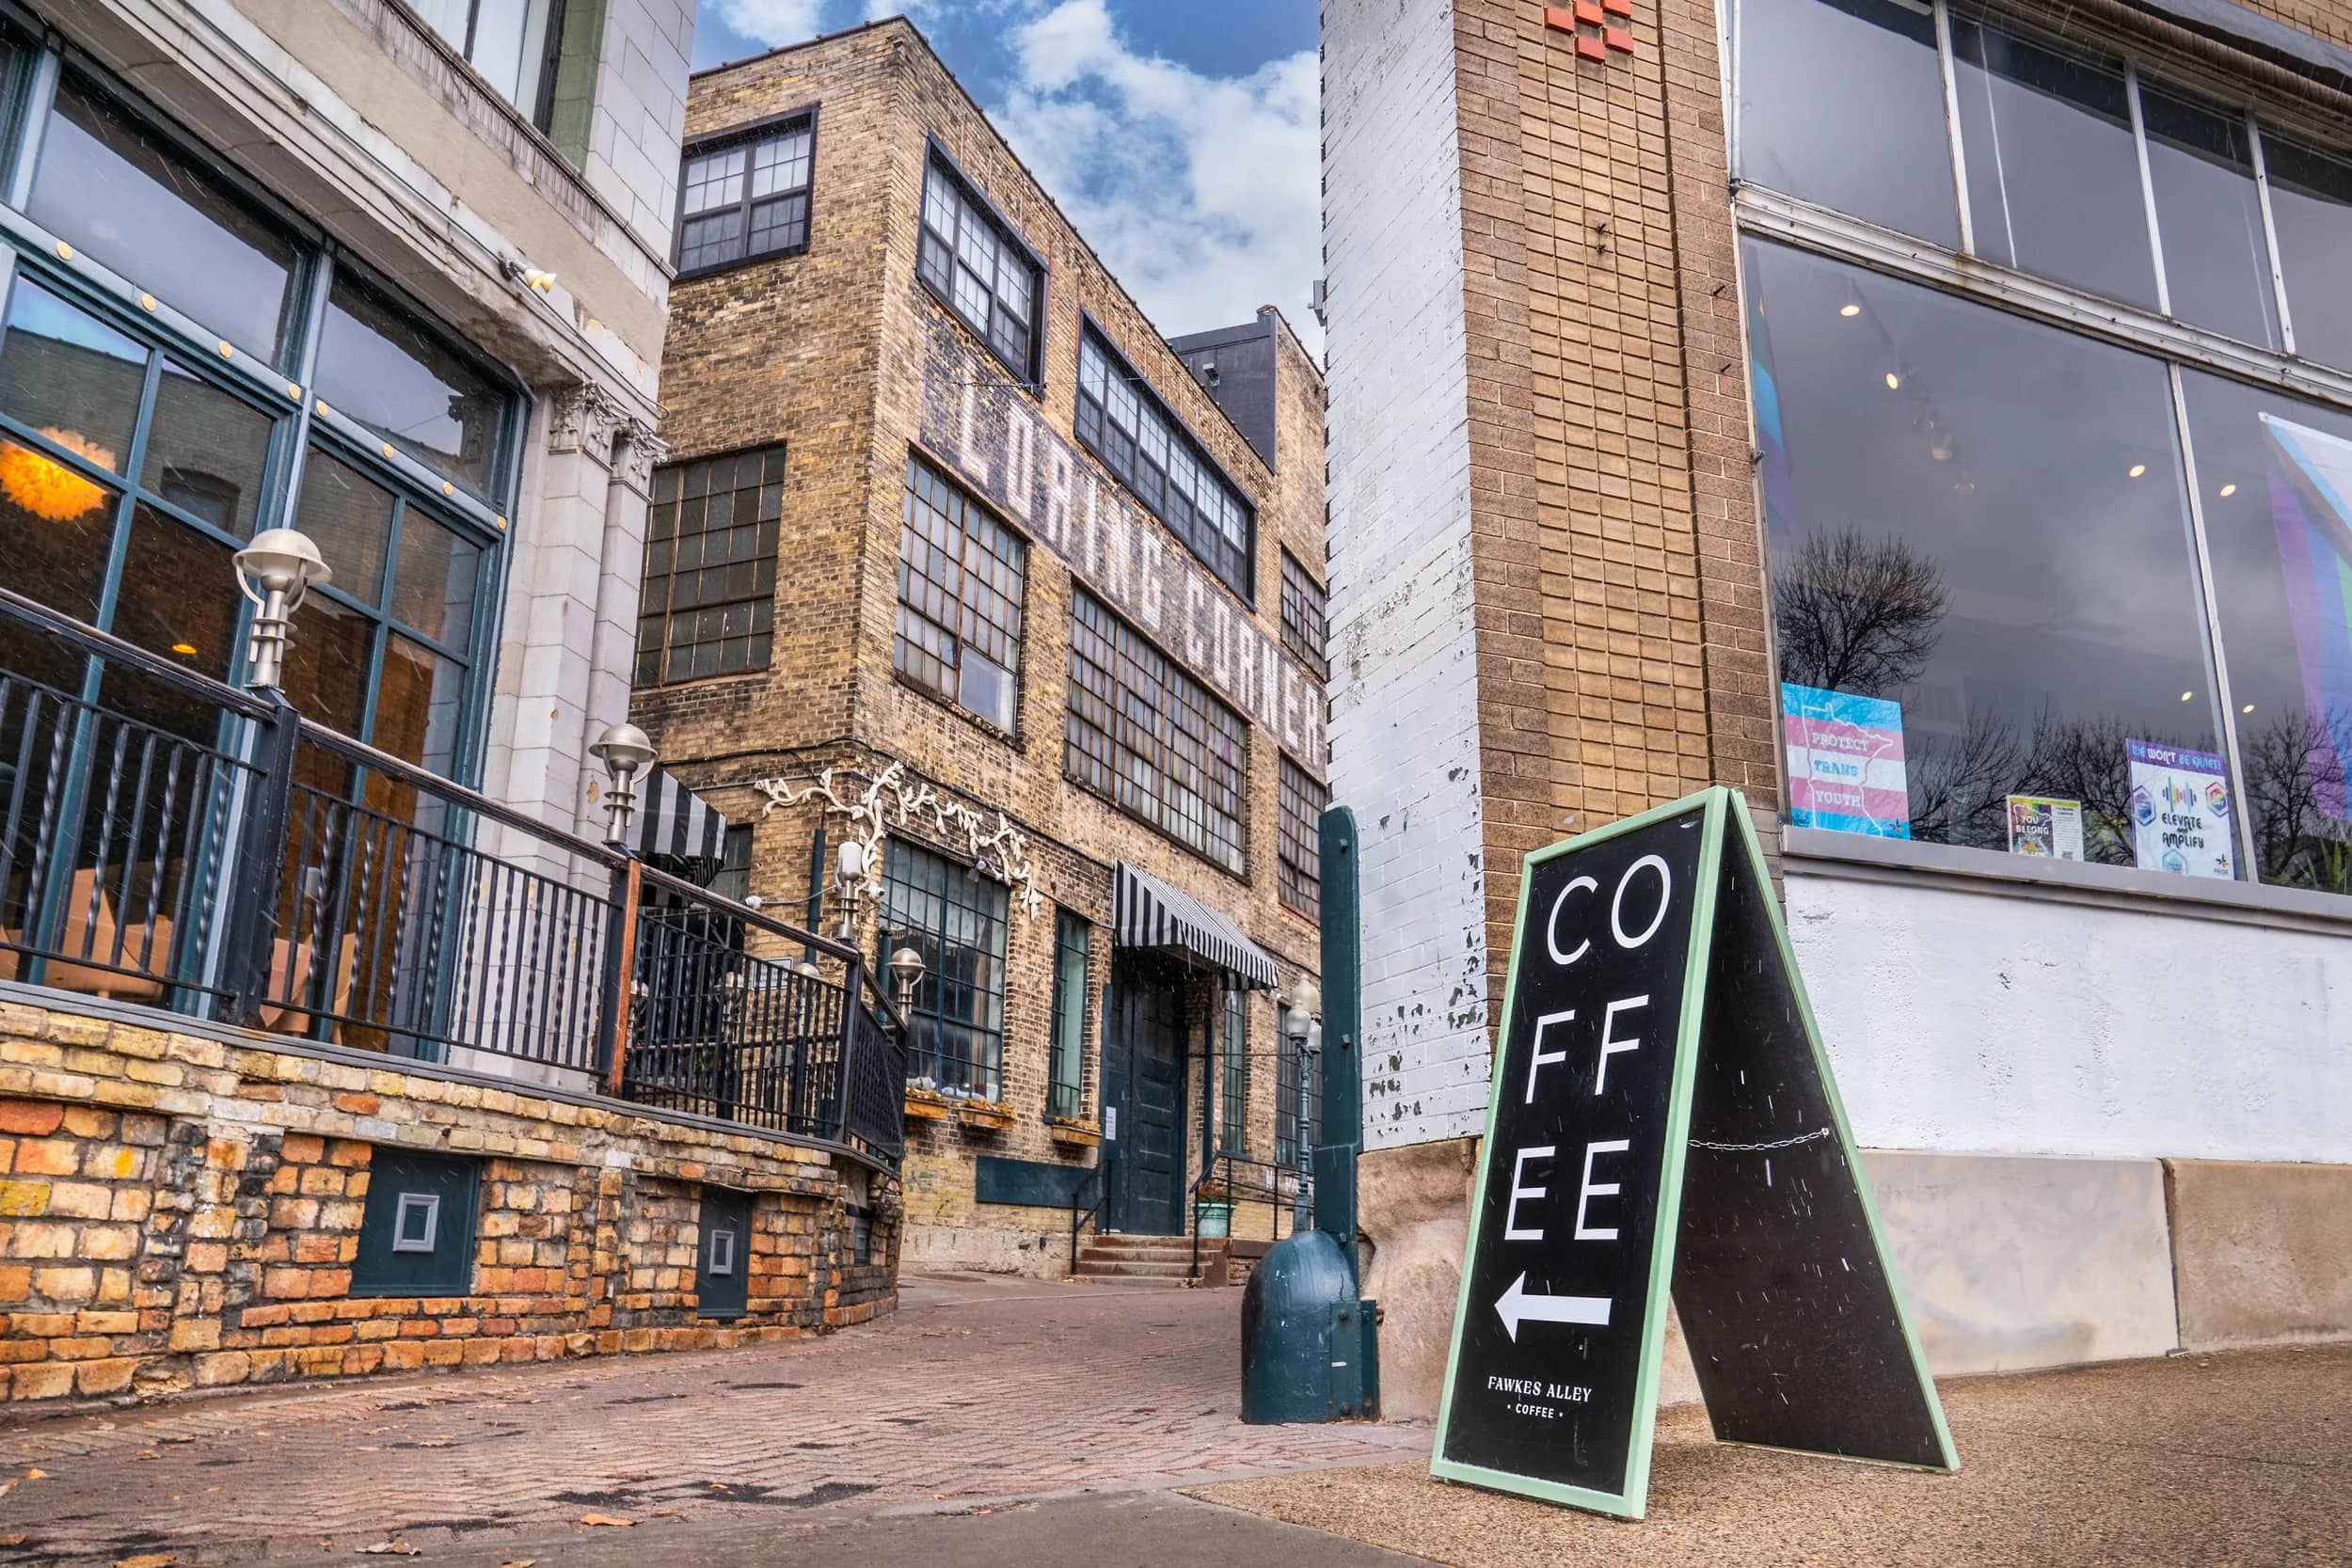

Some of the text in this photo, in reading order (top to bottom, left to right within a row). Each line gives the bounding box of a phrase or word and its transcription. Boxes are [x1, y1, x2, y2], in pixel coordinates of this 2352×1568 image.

[959, 357, 1318, 767] LORING CORNER
[1812, 732, 1869, 752] PROTECT
[2132, 744, 2221, 770] WE WON'T BE QUIET!
[1814, 759, 1859, 777] TRANS
[1815, 789, 1862, 807] YOUTH
[2022, 815, 2039, 825] YOU
[2162, 813, 2202, 831] ELEVATE
[2016, 825, 2049, 835] BELONG
[2162, 832, 2204, 848] AMPLIFY
[1487, 1375, 1592, 1402] FAWKES ALLEY
[1516, 1402, 1554, 1418] COFFEE
